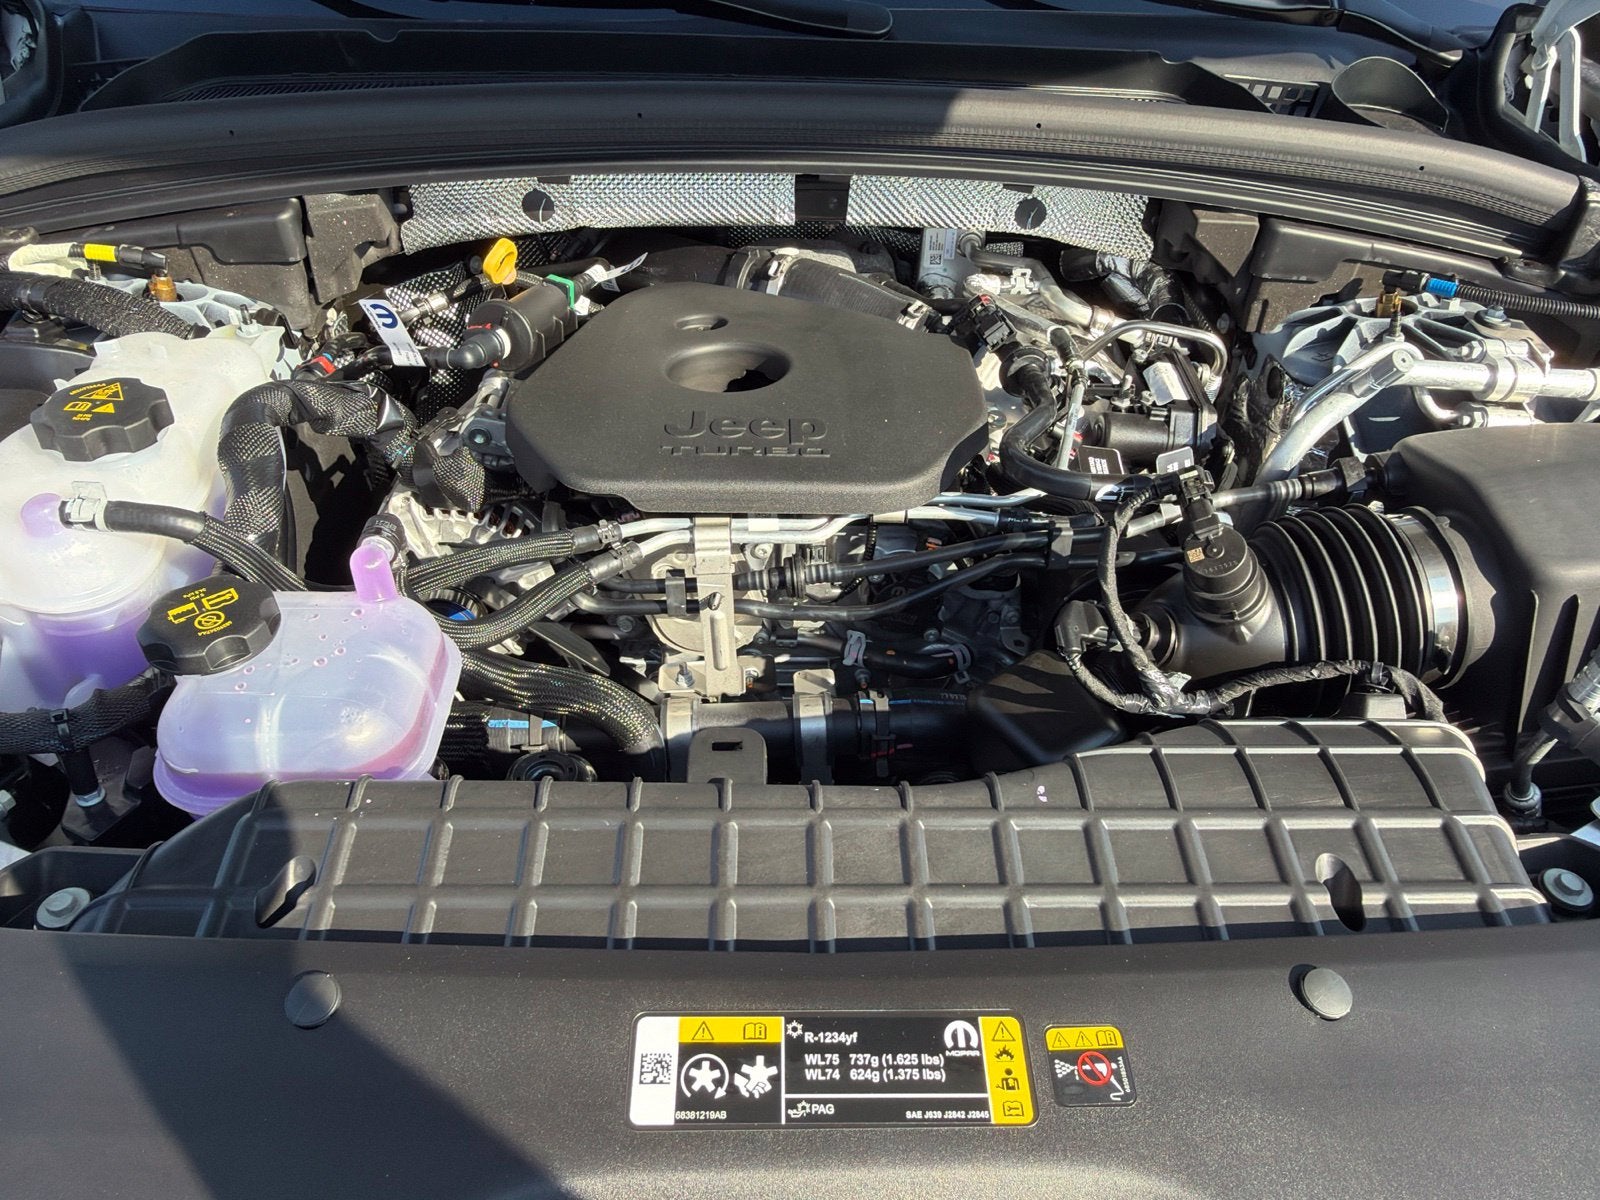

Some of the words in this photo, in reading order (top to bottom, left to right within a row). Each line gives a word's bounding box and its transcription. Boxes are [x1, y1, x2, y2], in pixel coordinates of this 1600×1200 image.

[663, 410, 829, 446] Jeep
[804, 1031, 858, 1045] R-1234yf
[804, 1053, 840, 1065] WL75
[849, 1053, 879, 1067] 737g
[882, 1053, 919, 1067] (1.625
[921, 1053, 945, 1067] lbs)
[804, 1068, 841, 1080] WL74
[849, 1068, 880, 1082] 624g
[882, 1068, 920, 1082] (1.375
[922, 1068, 946, 1082] lbs)
[674, 1110, 727, 1120] 68381219AB
[811, 1103, 835, 1115] PAG
[905, 1110, 923, 1119] SAE
[924, 1110, 942, 1119] J639
[943, 1110, 966, 1119] J2842
[966, 1110, 990, 1119] J2845
